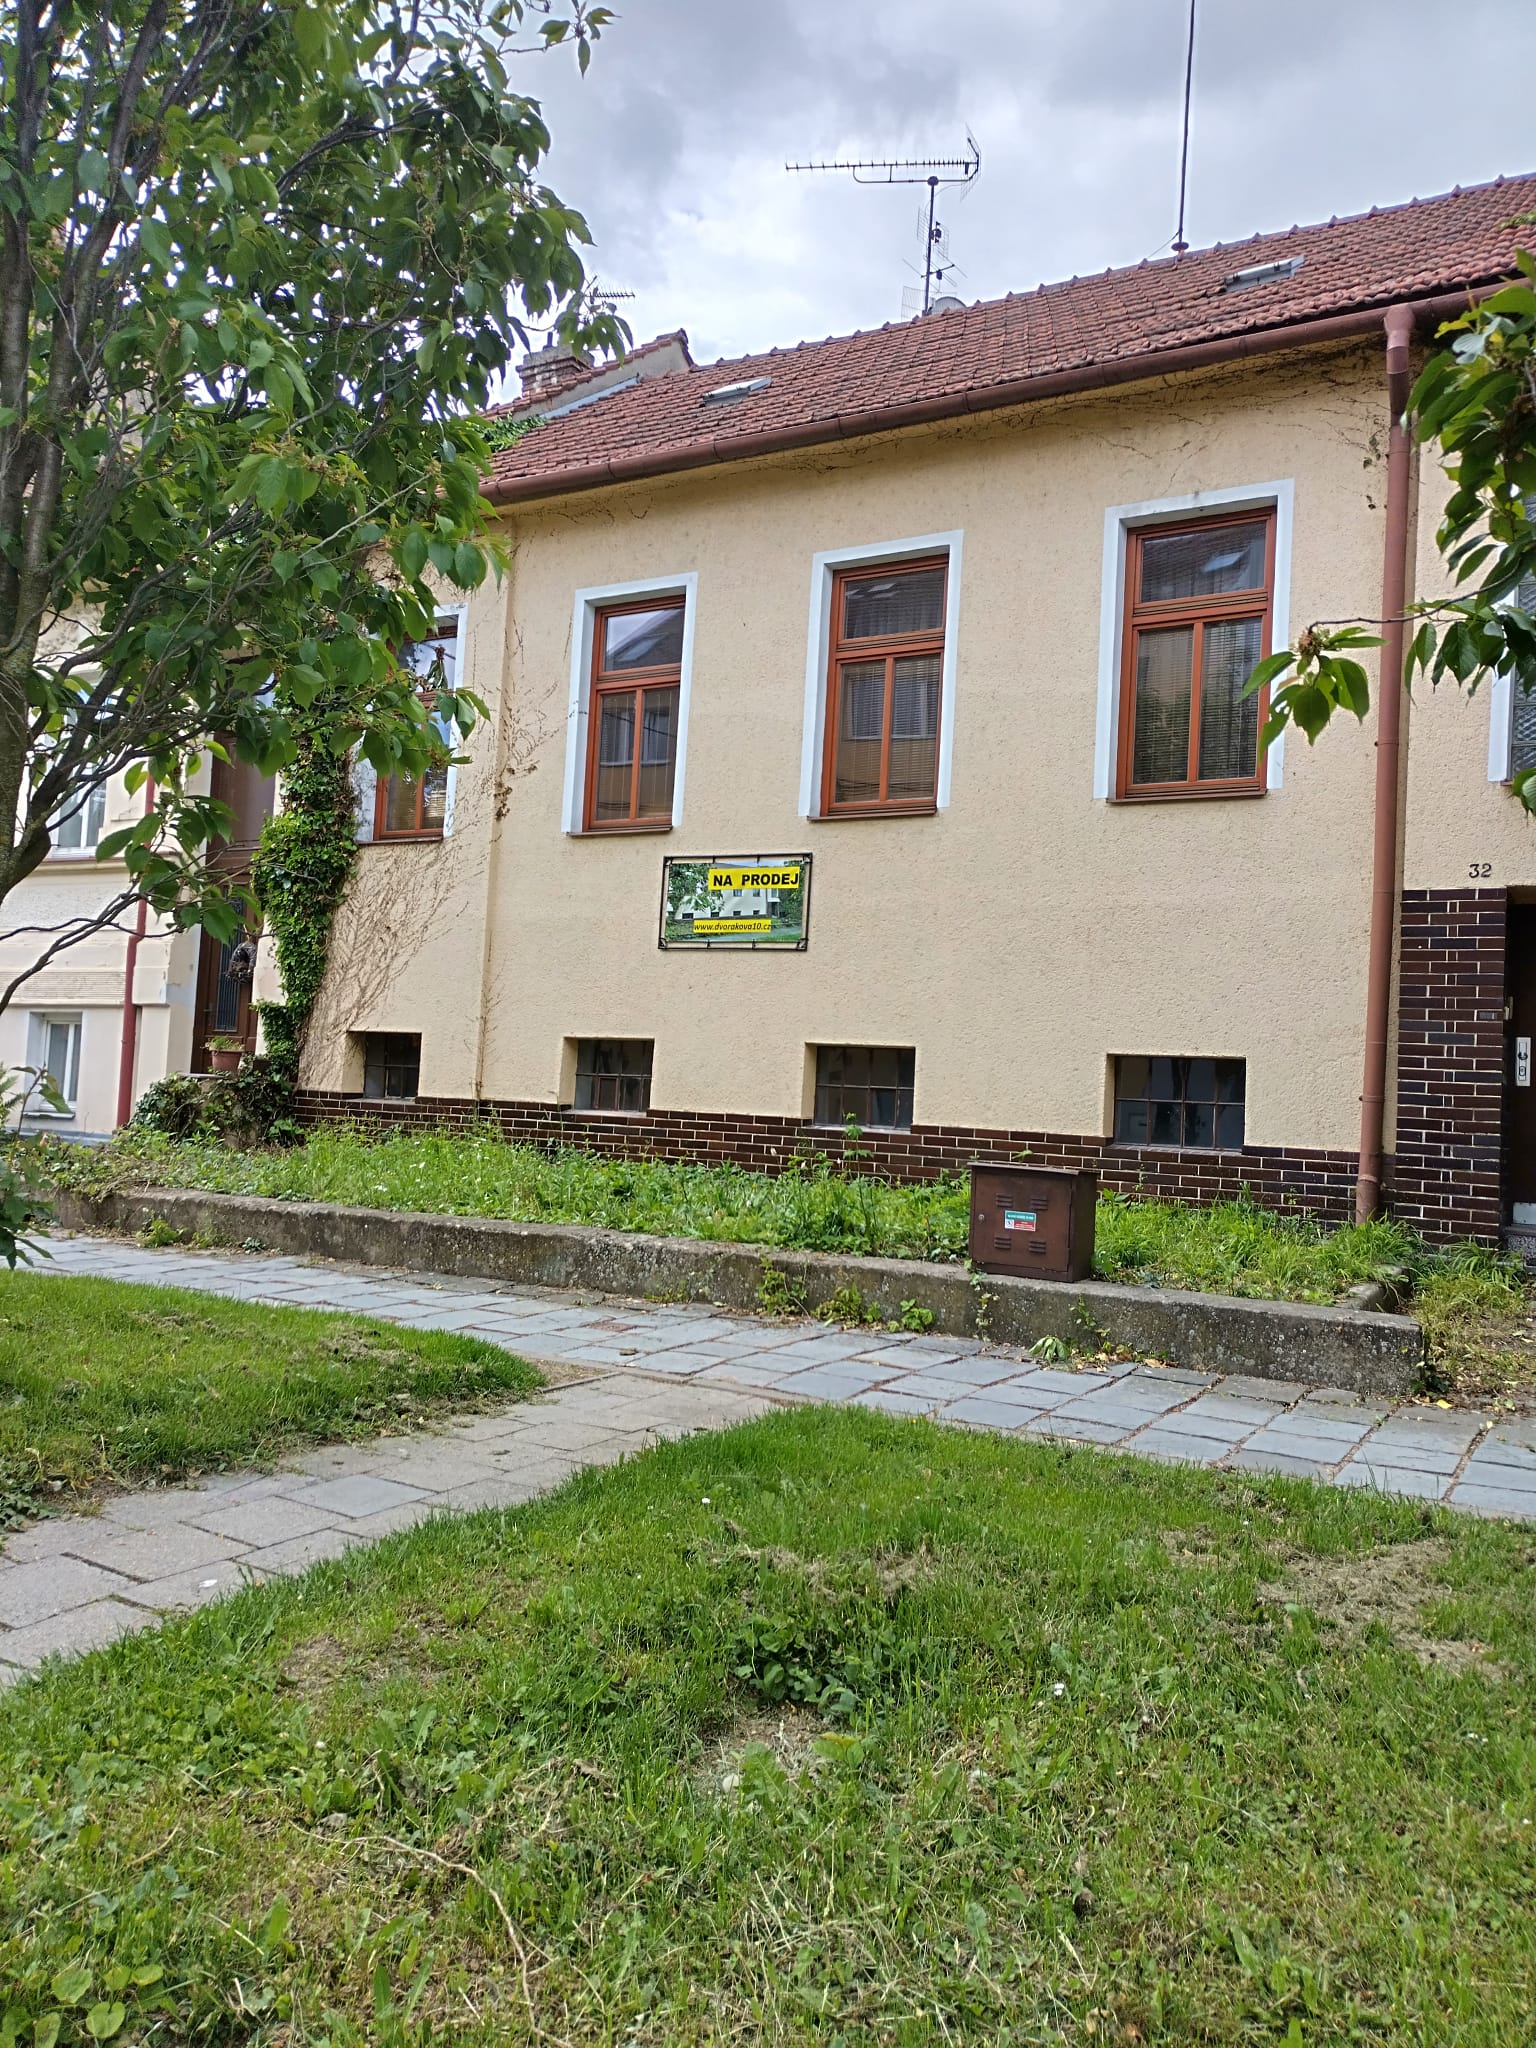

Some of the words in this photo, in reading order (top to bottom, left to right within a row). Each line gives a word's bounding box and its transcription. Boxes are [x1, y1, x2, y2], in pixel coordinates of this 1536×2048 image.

[1468, 863, 1492, 878] 32
[713, 874, 733, 886] NA
[741, 873, 799, 886] PRODEJ
[694, 922, 771, 931] www.dvorakova10.cz
